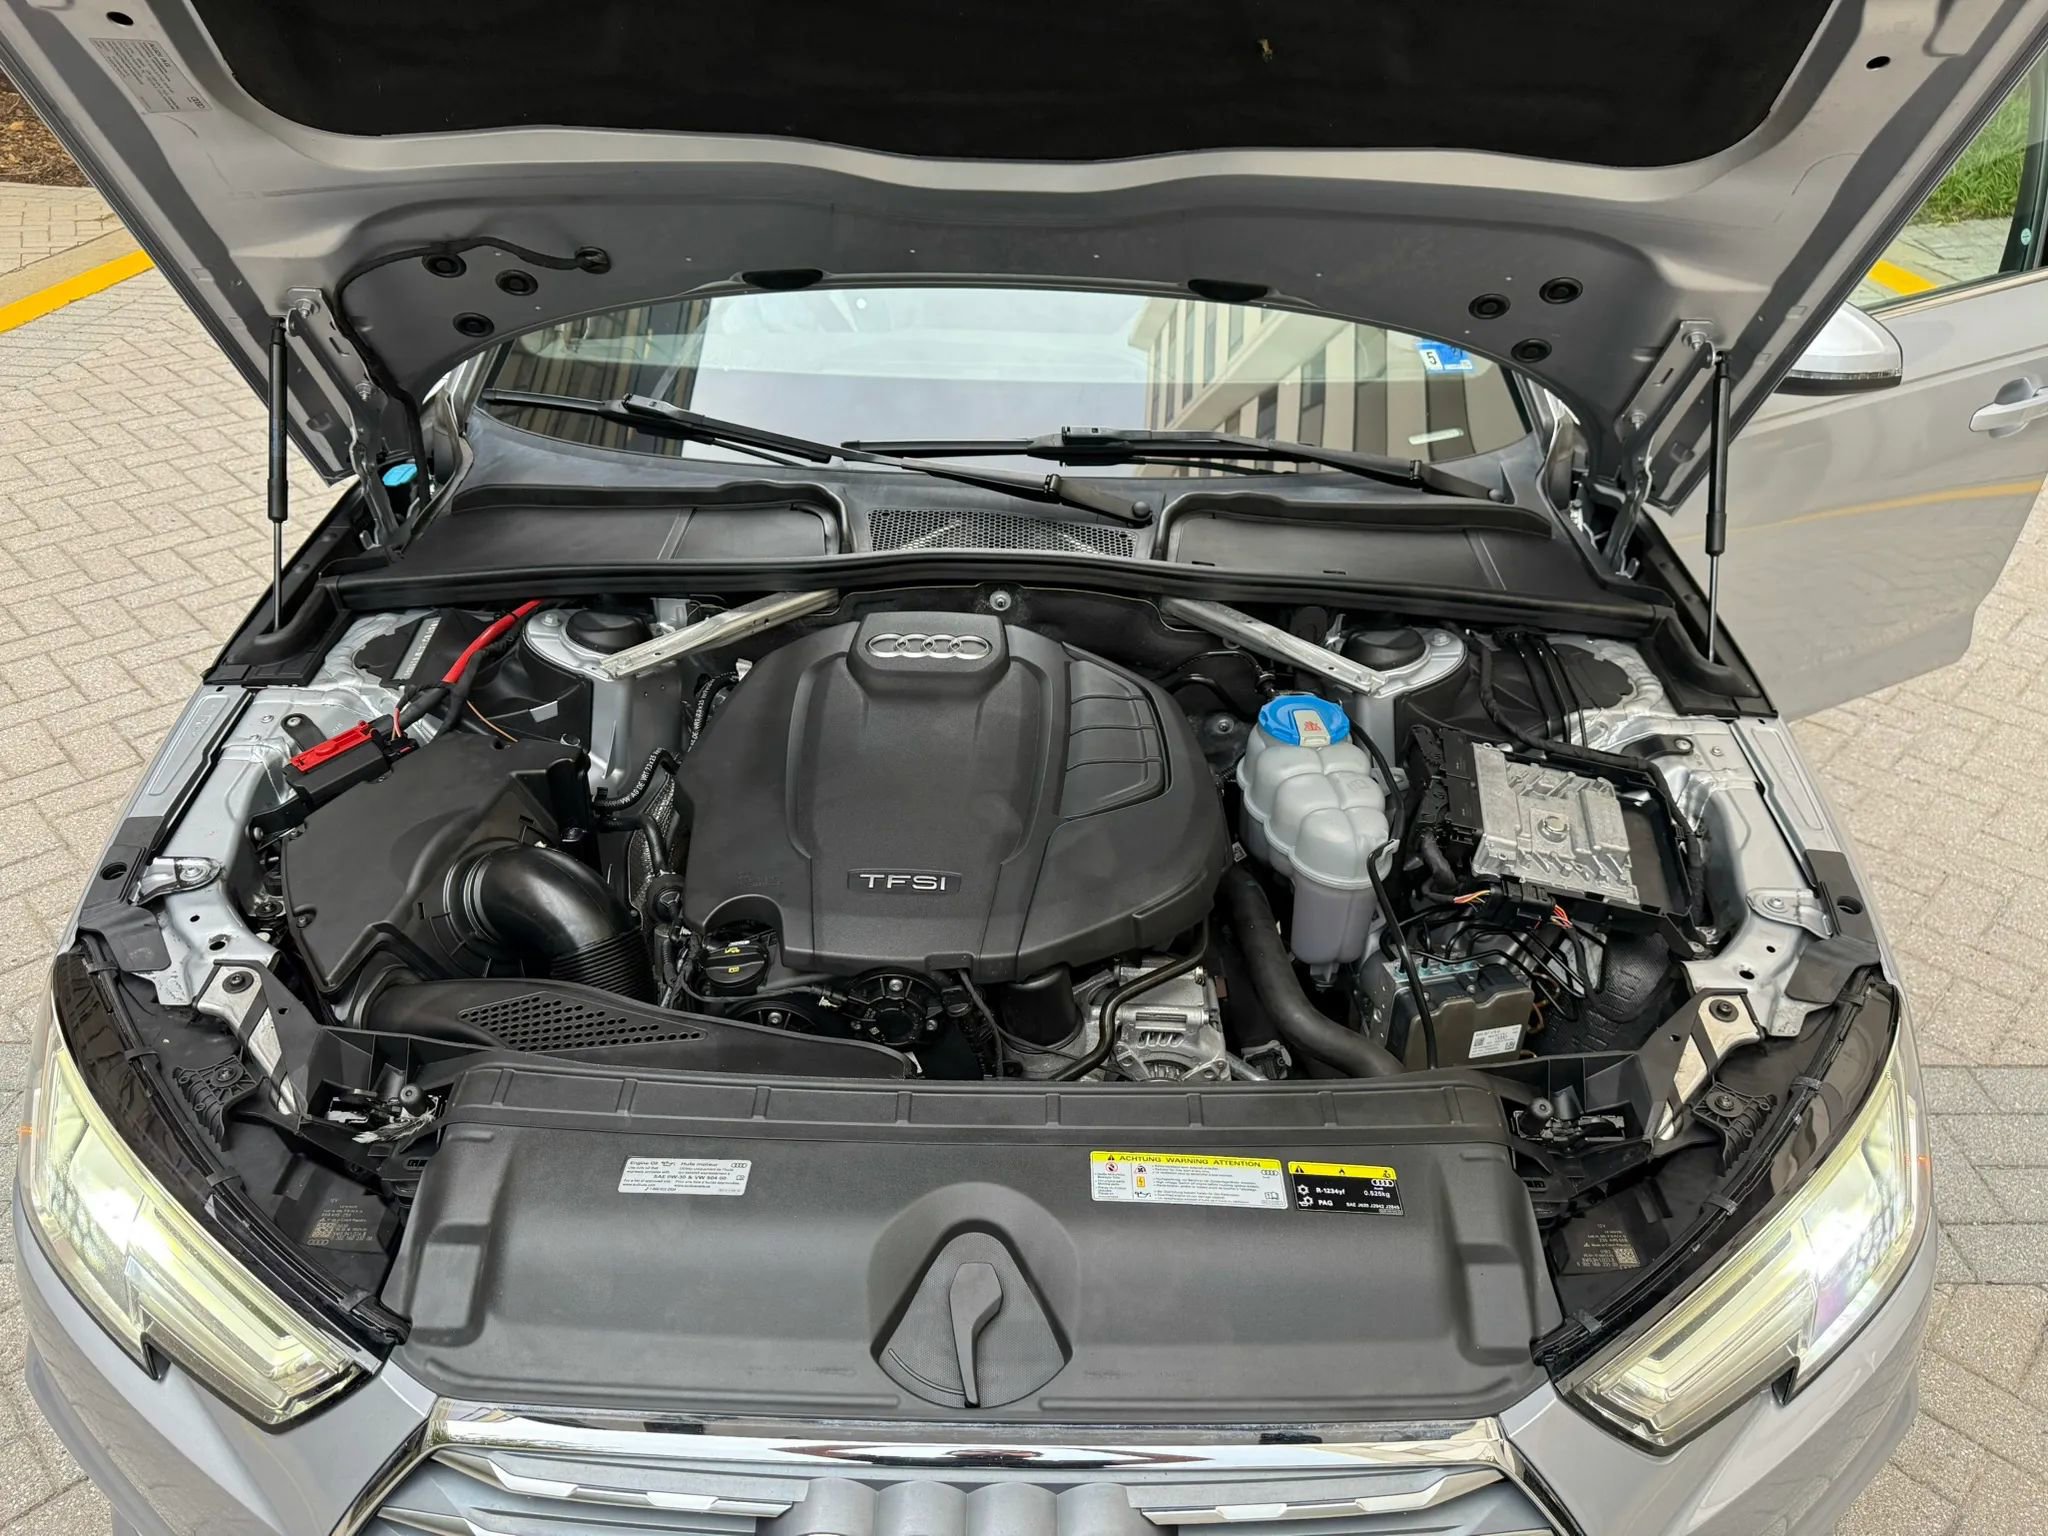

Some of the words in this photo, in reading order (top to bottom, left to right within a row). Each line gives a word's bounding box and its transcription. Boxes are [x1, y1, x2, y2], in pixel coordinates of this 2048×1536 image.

[1426, 351, 1437, 365] 5
[859, 873, 946, 891] TFSI
[1119, 1155, 1162, 1163] ACHTUNG
[1166, 1157, 1209, 1165] WARNING
[1213, 1159, 1261, 1167] ATTENTION
[1315, 1187, 1345, 1196] R-1234yf
[1363, 1190, 1391, 1199] 0.525kg
[1318, 1199, 1334, 1207] PAG
